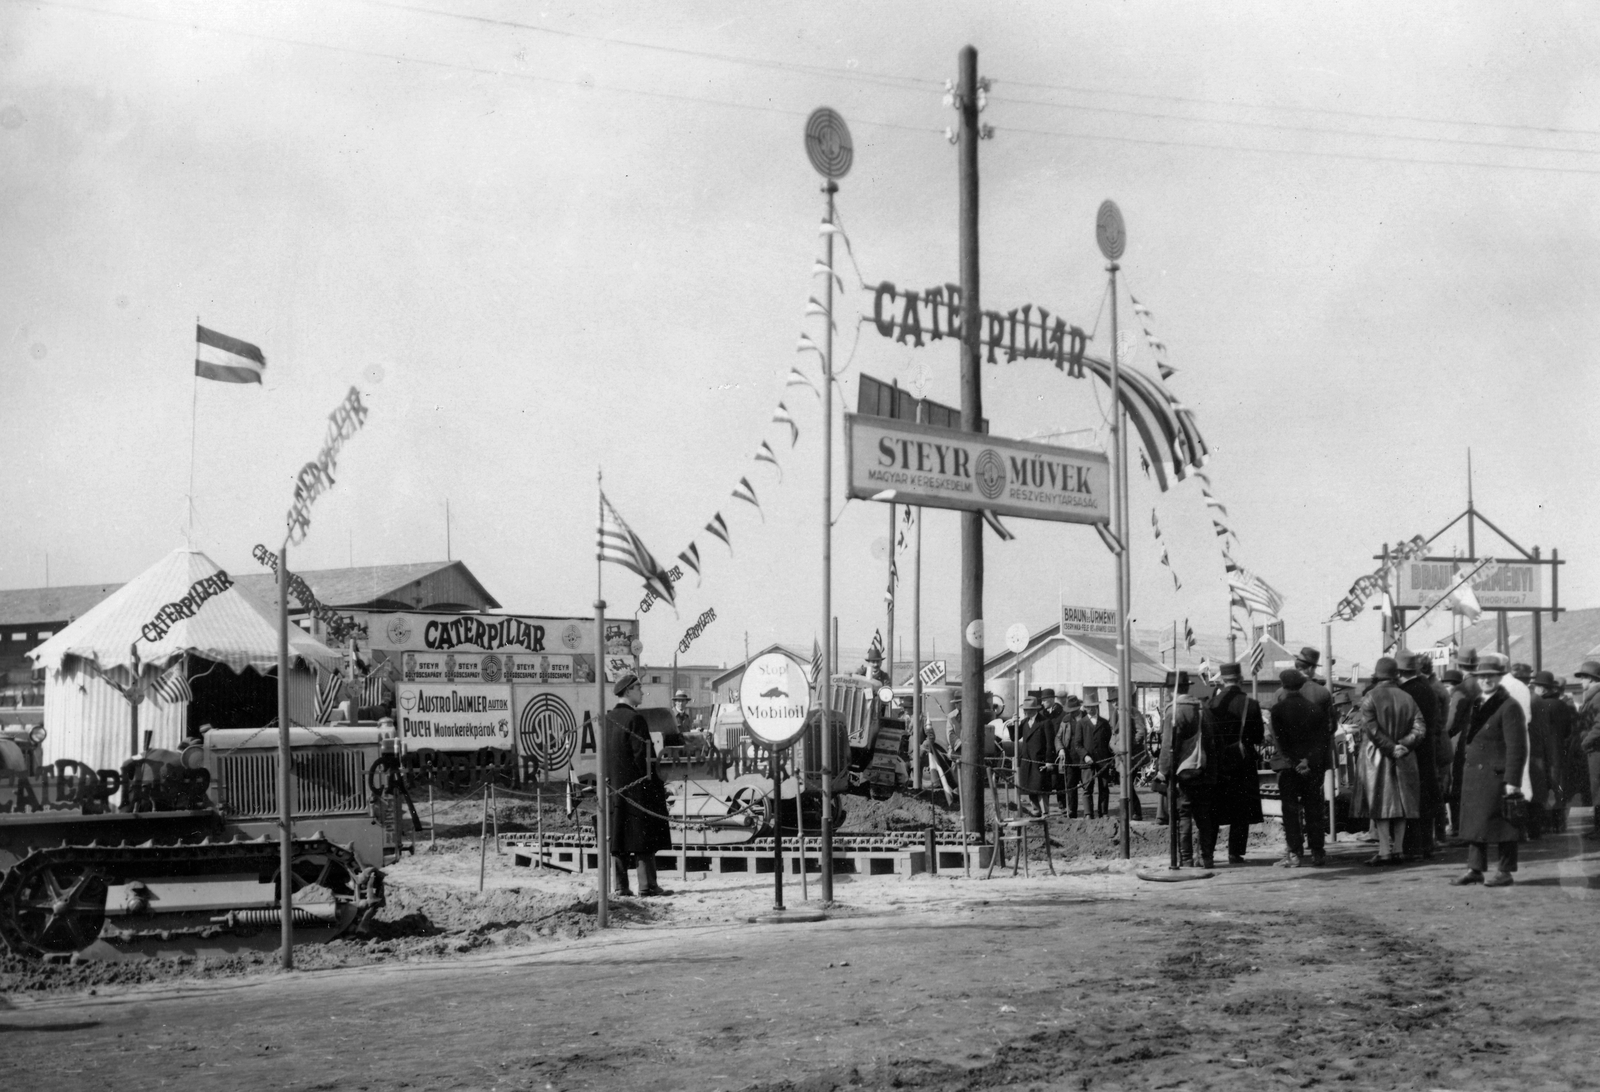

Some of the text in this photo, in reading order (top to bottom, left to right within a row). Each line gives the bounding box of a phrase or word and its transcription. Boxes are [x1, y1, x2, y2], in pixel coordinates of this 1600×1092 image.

[874, 281, 1086, 379] CATEPILLAR
[878, 436, 971, 478] STEYR
[1009, 454, 1092, 494] MŰVEK
[867, 469, 908, 484] MAGYAR
[141, 569, 234, 643] CATERPILLAR
[1064, 608, 1086, 622] BRAUN
[424, 616, 546, 652] CATERPILLAR
[419, 662, 439, 670] STEYR
[458, 662, 478, 670] STEYR
[920, 661, 945, 685] LINE
[748, 704, 804, 719] Mobiloil
[434, 722, 497, 739] Motorkerékpárok
